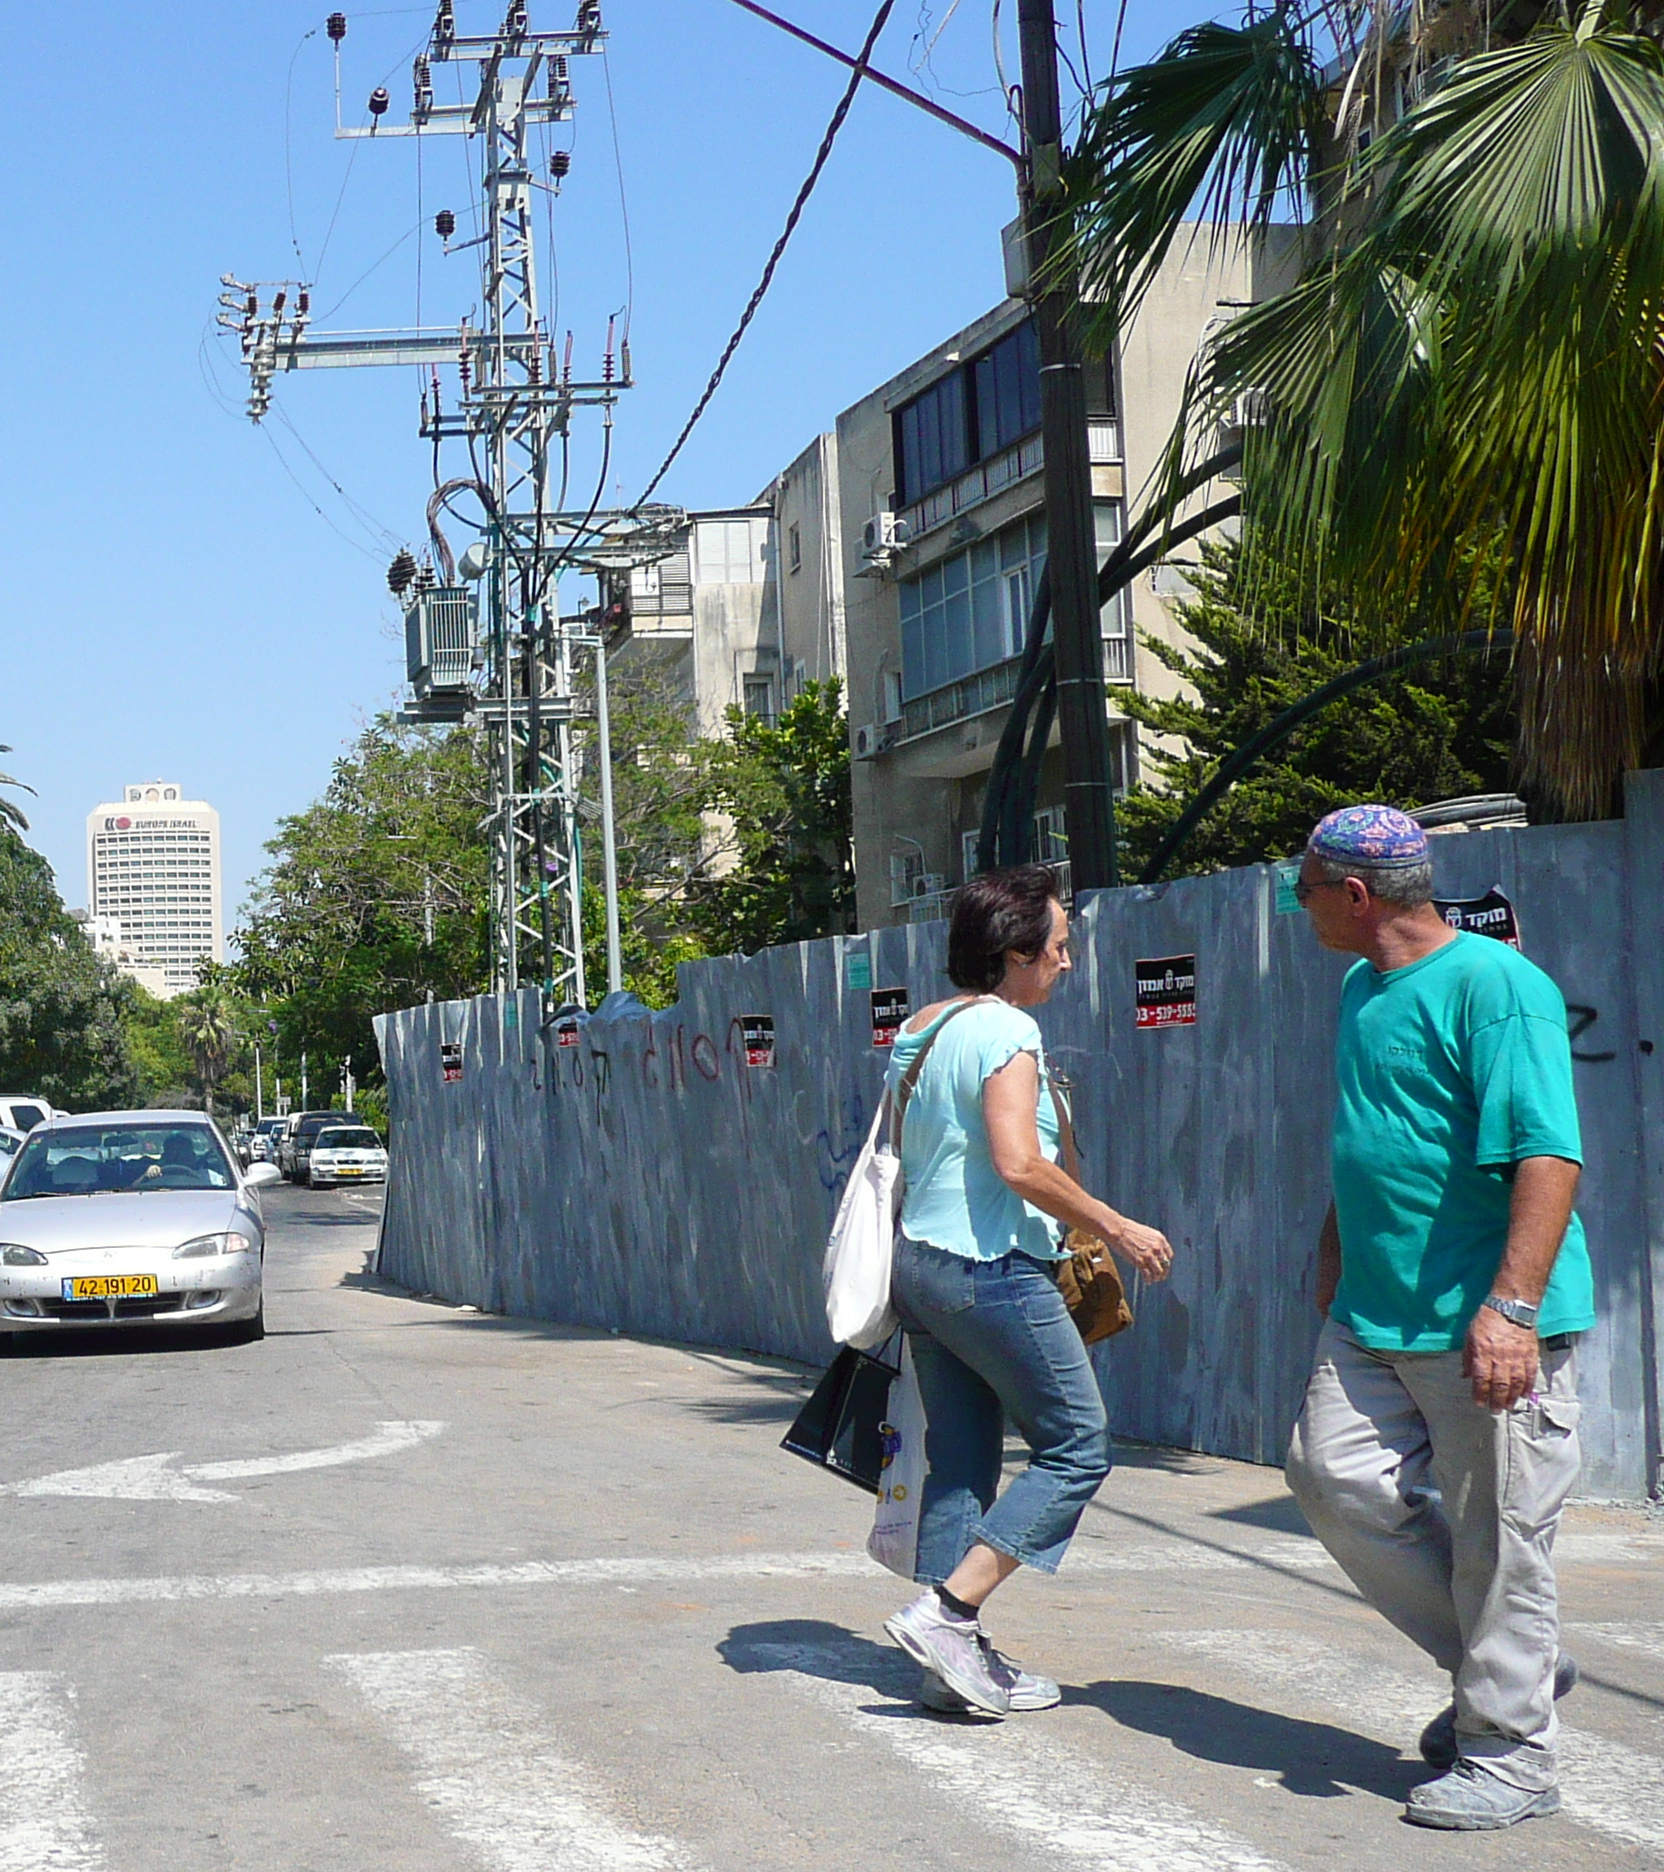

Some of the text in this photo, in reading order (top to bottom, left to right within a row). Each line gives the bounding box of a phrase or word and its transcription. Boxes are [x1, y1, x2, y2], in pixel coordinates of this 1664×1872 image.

[1465, 907, 1507, 928] מוקד
[79, 1276, 151, 1296] 42 191 20
